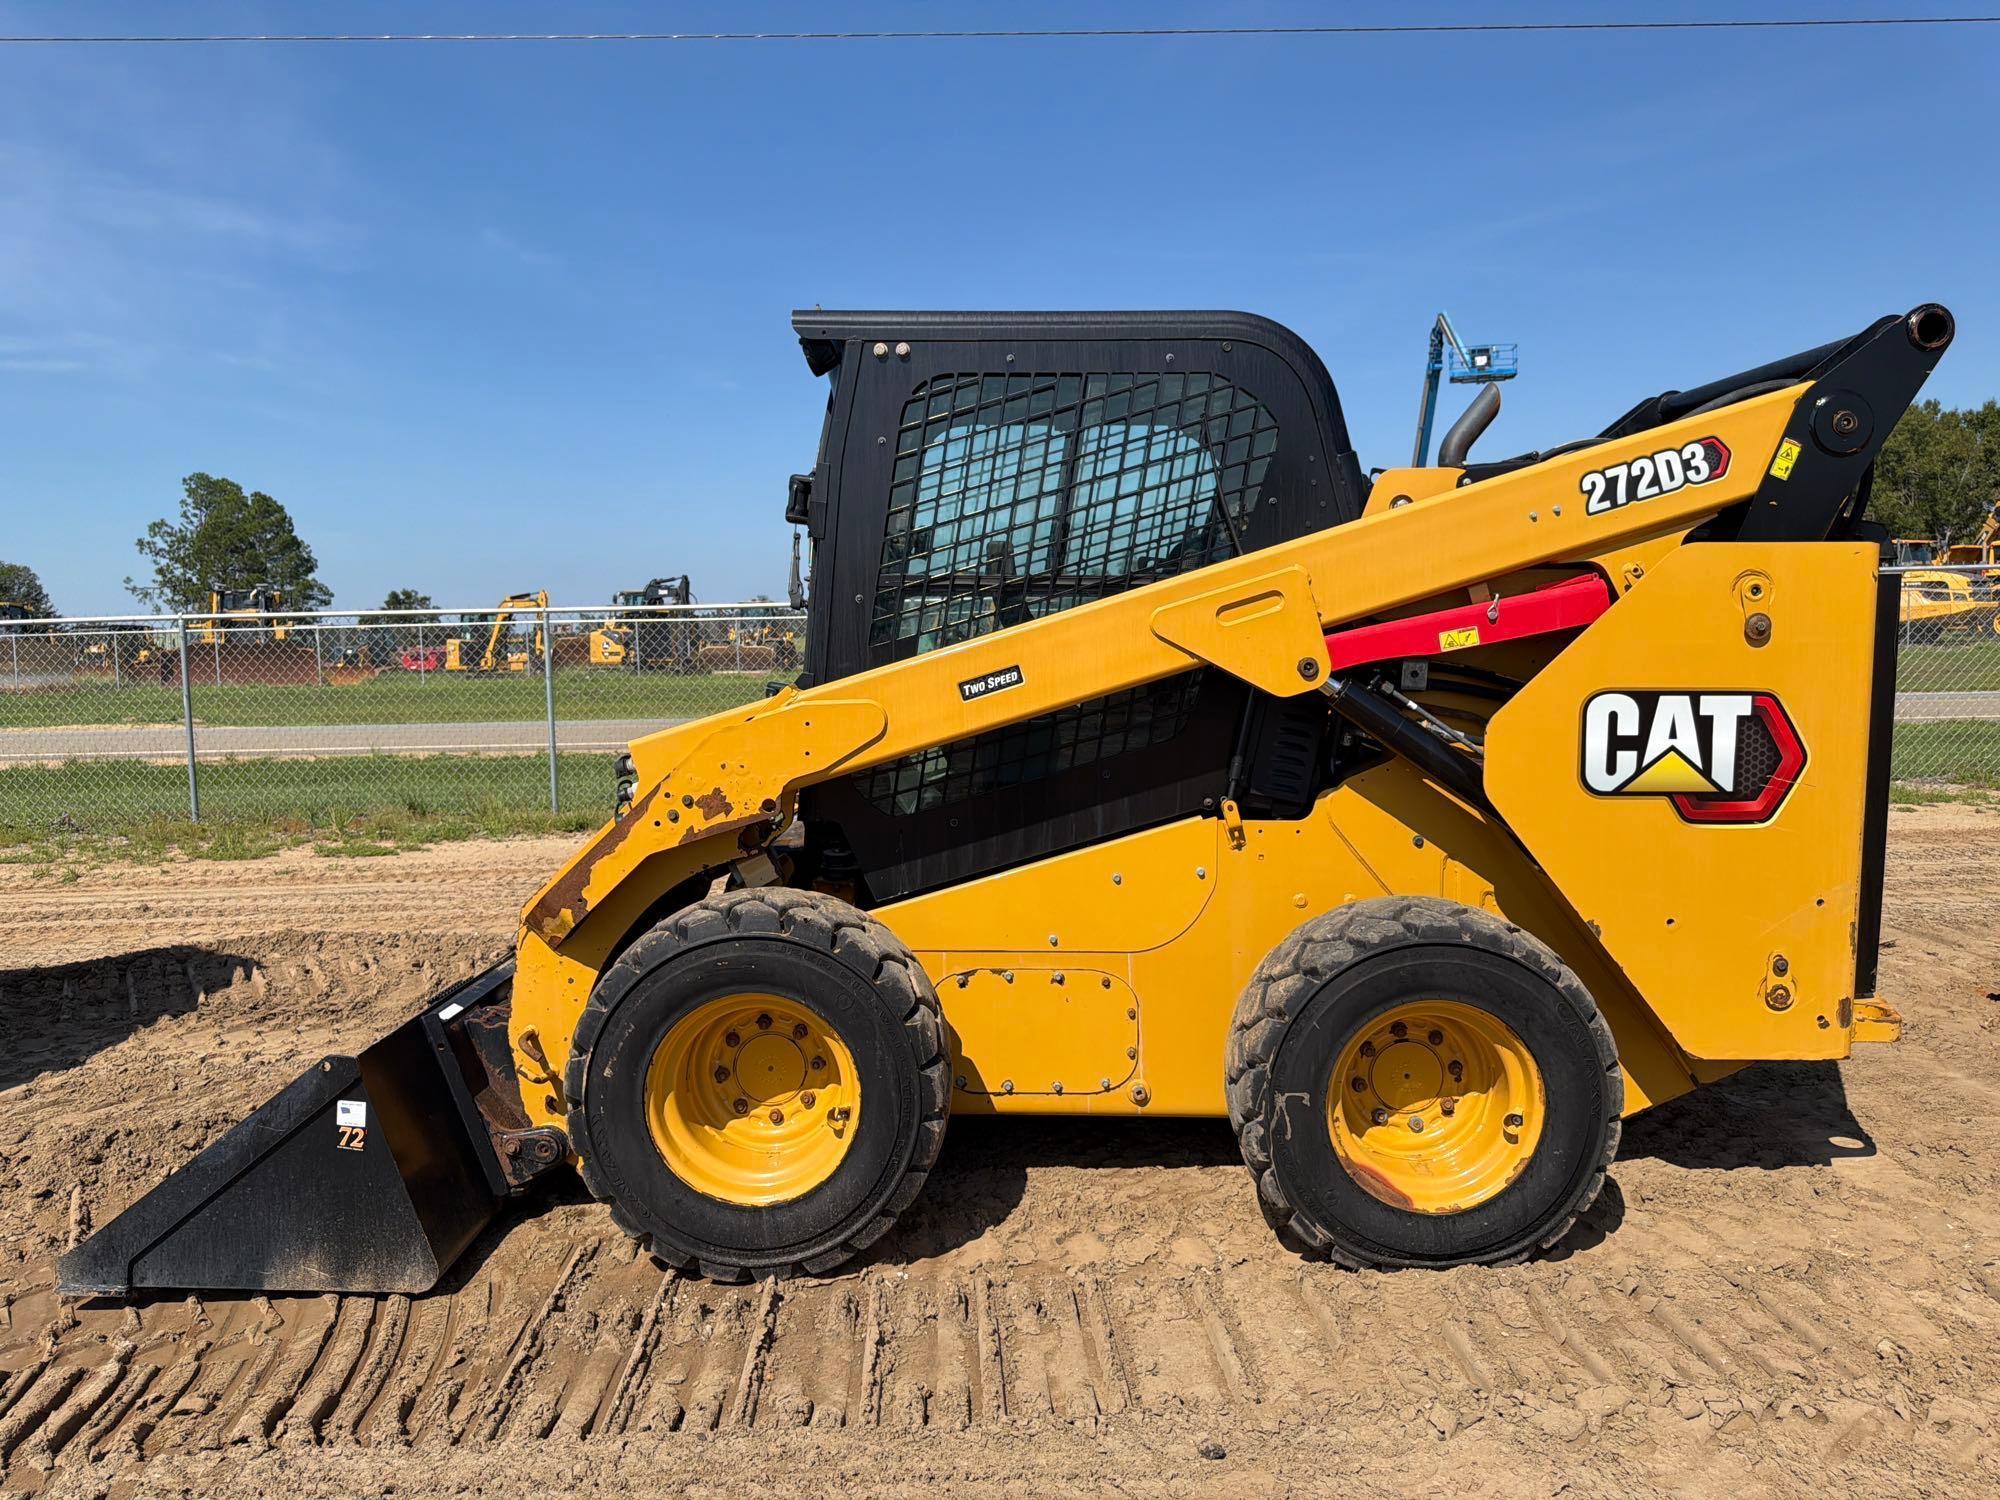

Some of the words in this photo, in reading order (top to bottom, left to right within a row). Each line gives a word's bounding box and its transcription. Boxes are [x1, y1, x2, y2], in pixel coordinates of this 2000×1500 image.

[1581, 443, 1710, 514] 272D3
[963, 681, 986, 696] TWO
[987, 671, 1018, 689] SPEED
[1585, 693, 1753, 792] CAT
